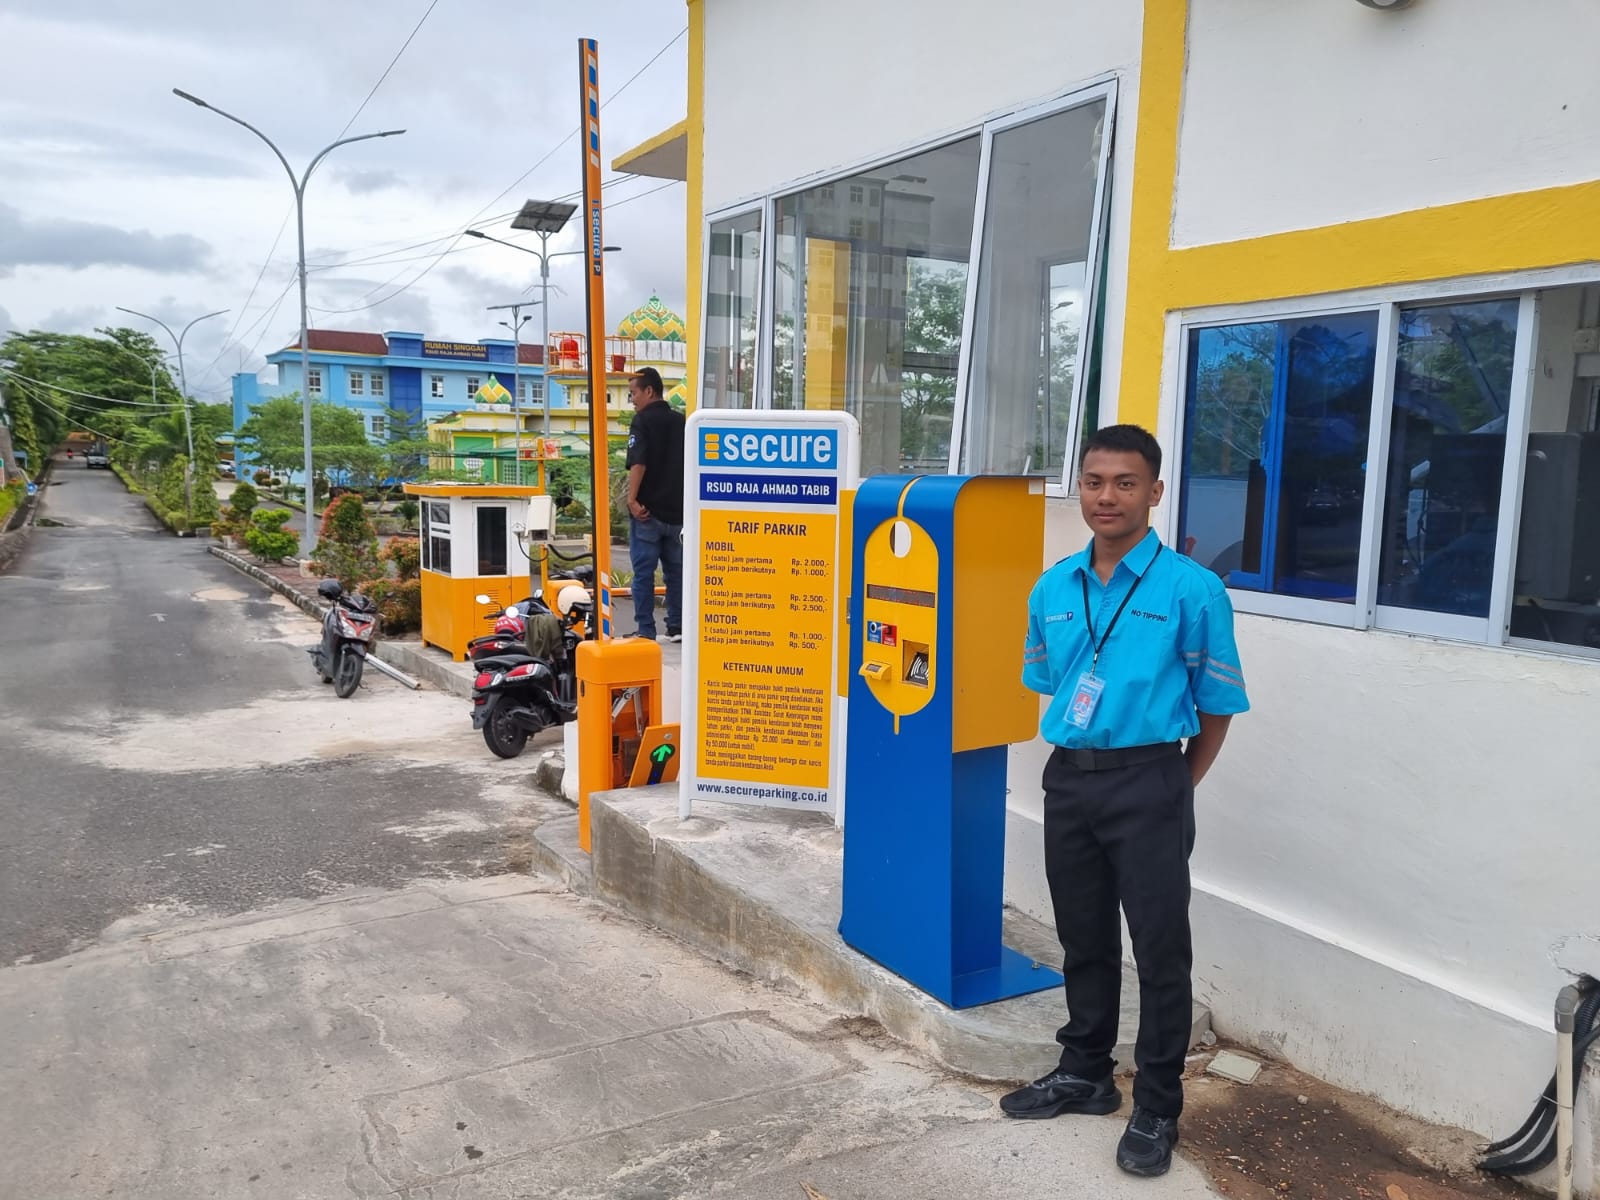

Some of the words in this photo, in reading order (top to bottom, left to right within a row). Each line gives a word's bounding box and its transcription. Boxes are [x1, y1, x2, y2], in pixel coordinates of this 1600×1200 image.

[724, 434, 831, 462] secure
[707, 482, 733, 493] RSUD
[736, 482, 758, 494] RAJA
[762, 484, 798, 495] AHMAD
[801, 484, 830, 496] TABIB
[728, 521, 759, 534] TARIF
[764, 523, 807, 536] PARKIR
[706, 541, 735, 552] MOBIL
[742, 566, 775, 574] berikutnya
[705, 576, 723, 586] BOX
[741, 600, 775, 609] berikutnya
[705, 614, 738, 624] MOTOR
[1143, 612, 1168, 622] TIPPING
[740, 638, 774, 647] berikutnya
[724, 662, 772, 674] KETENTUAN
[776, 666, 804, 676] UMUM
[697, 783, 828, 802] www.secureparking.co.id
